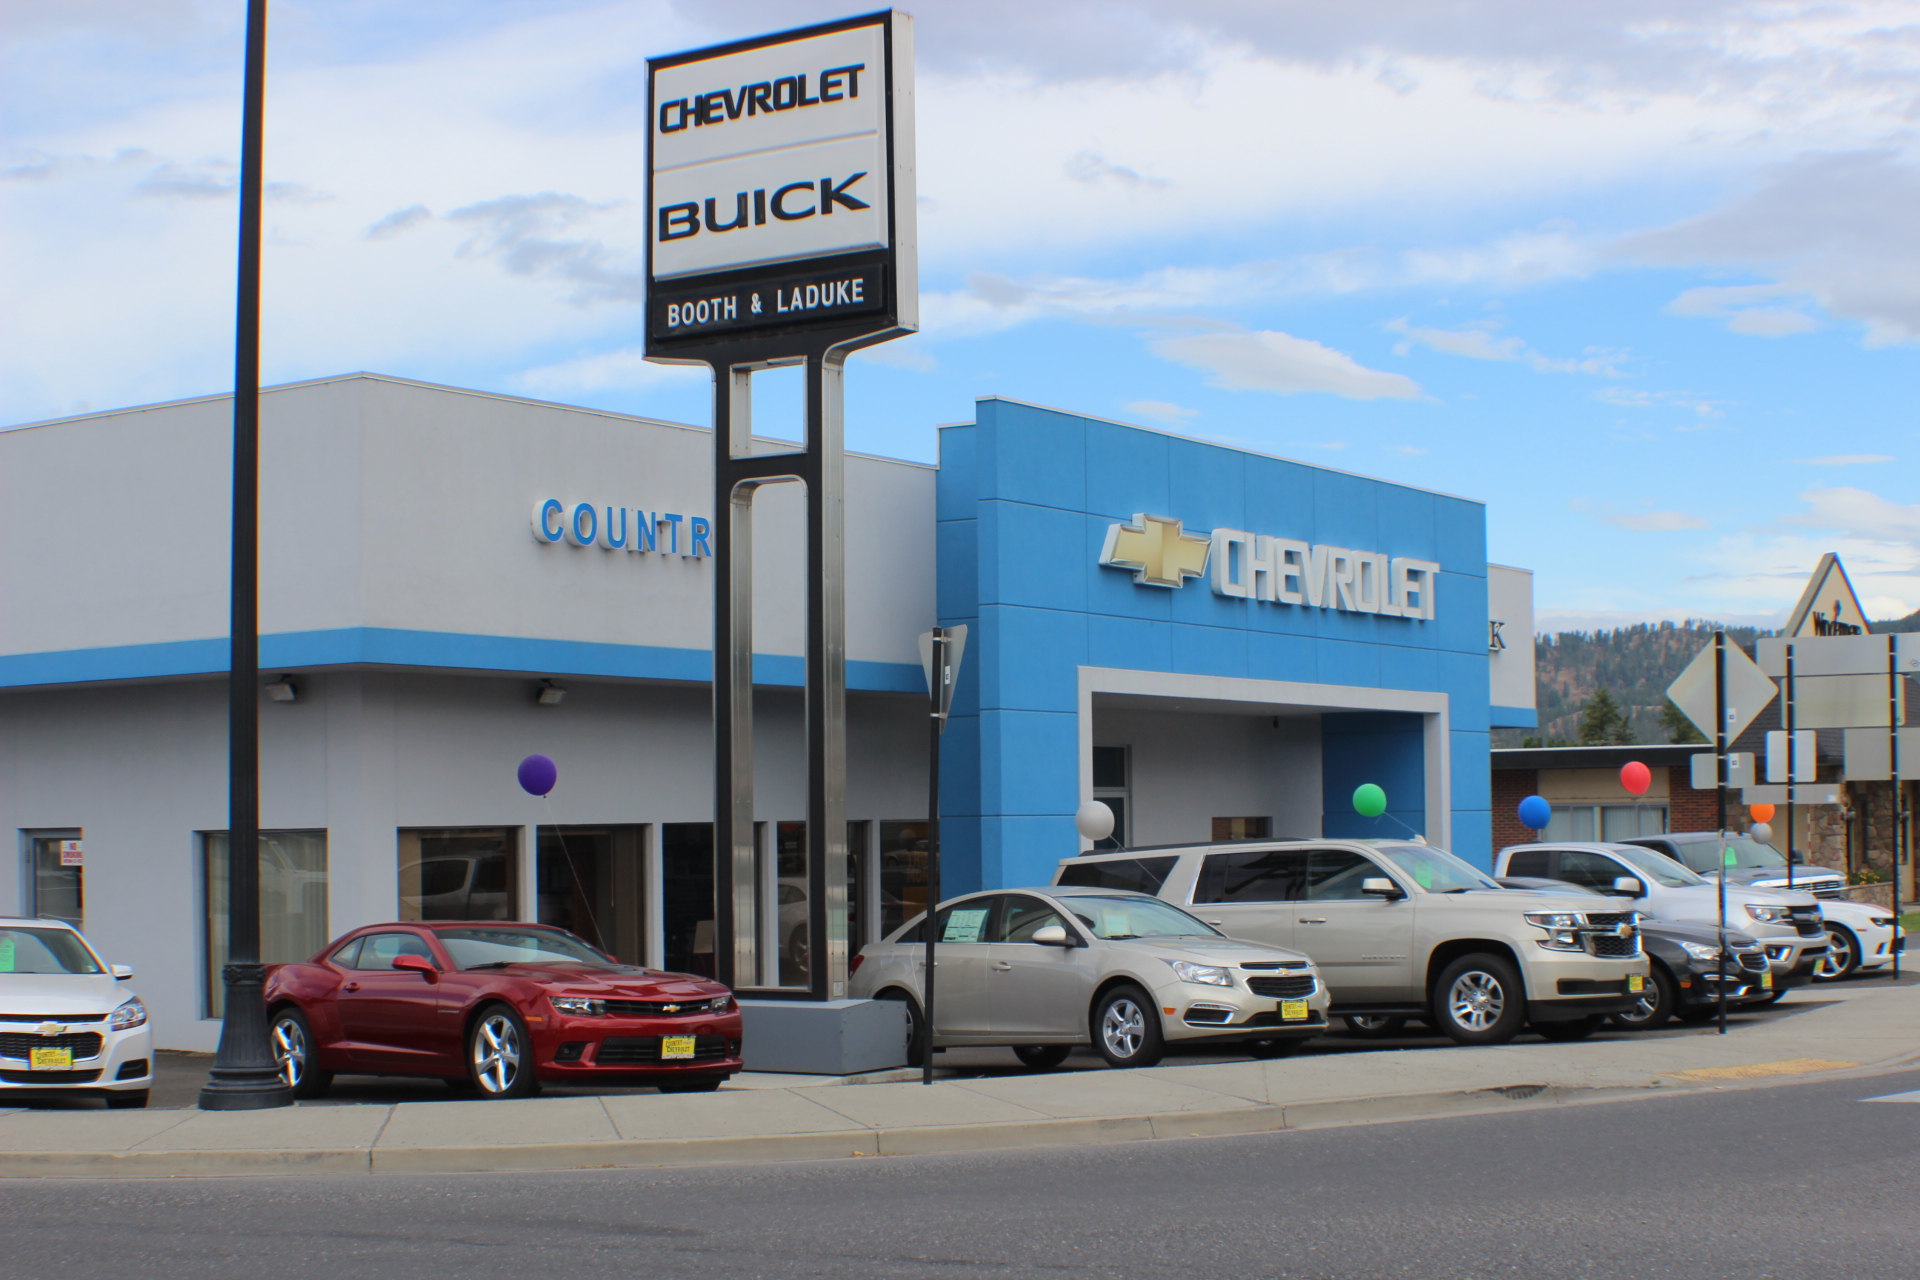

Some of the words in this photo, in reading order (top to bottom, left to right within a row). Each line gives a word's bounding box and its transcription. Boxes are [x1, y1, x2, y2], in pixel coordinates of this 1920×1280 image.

[660, 63, 865, 134] CHEVROLET
[659, 171, 870, 242] BUICK
[668, 296, 737, 328] BOOTH
[751, 292, 762, 314] &
[777, 278, 864, 313] LADUKE
[532, 498, 712, 557] COUNTR
[1211, 527, 1440, 620] CHEVROLET
